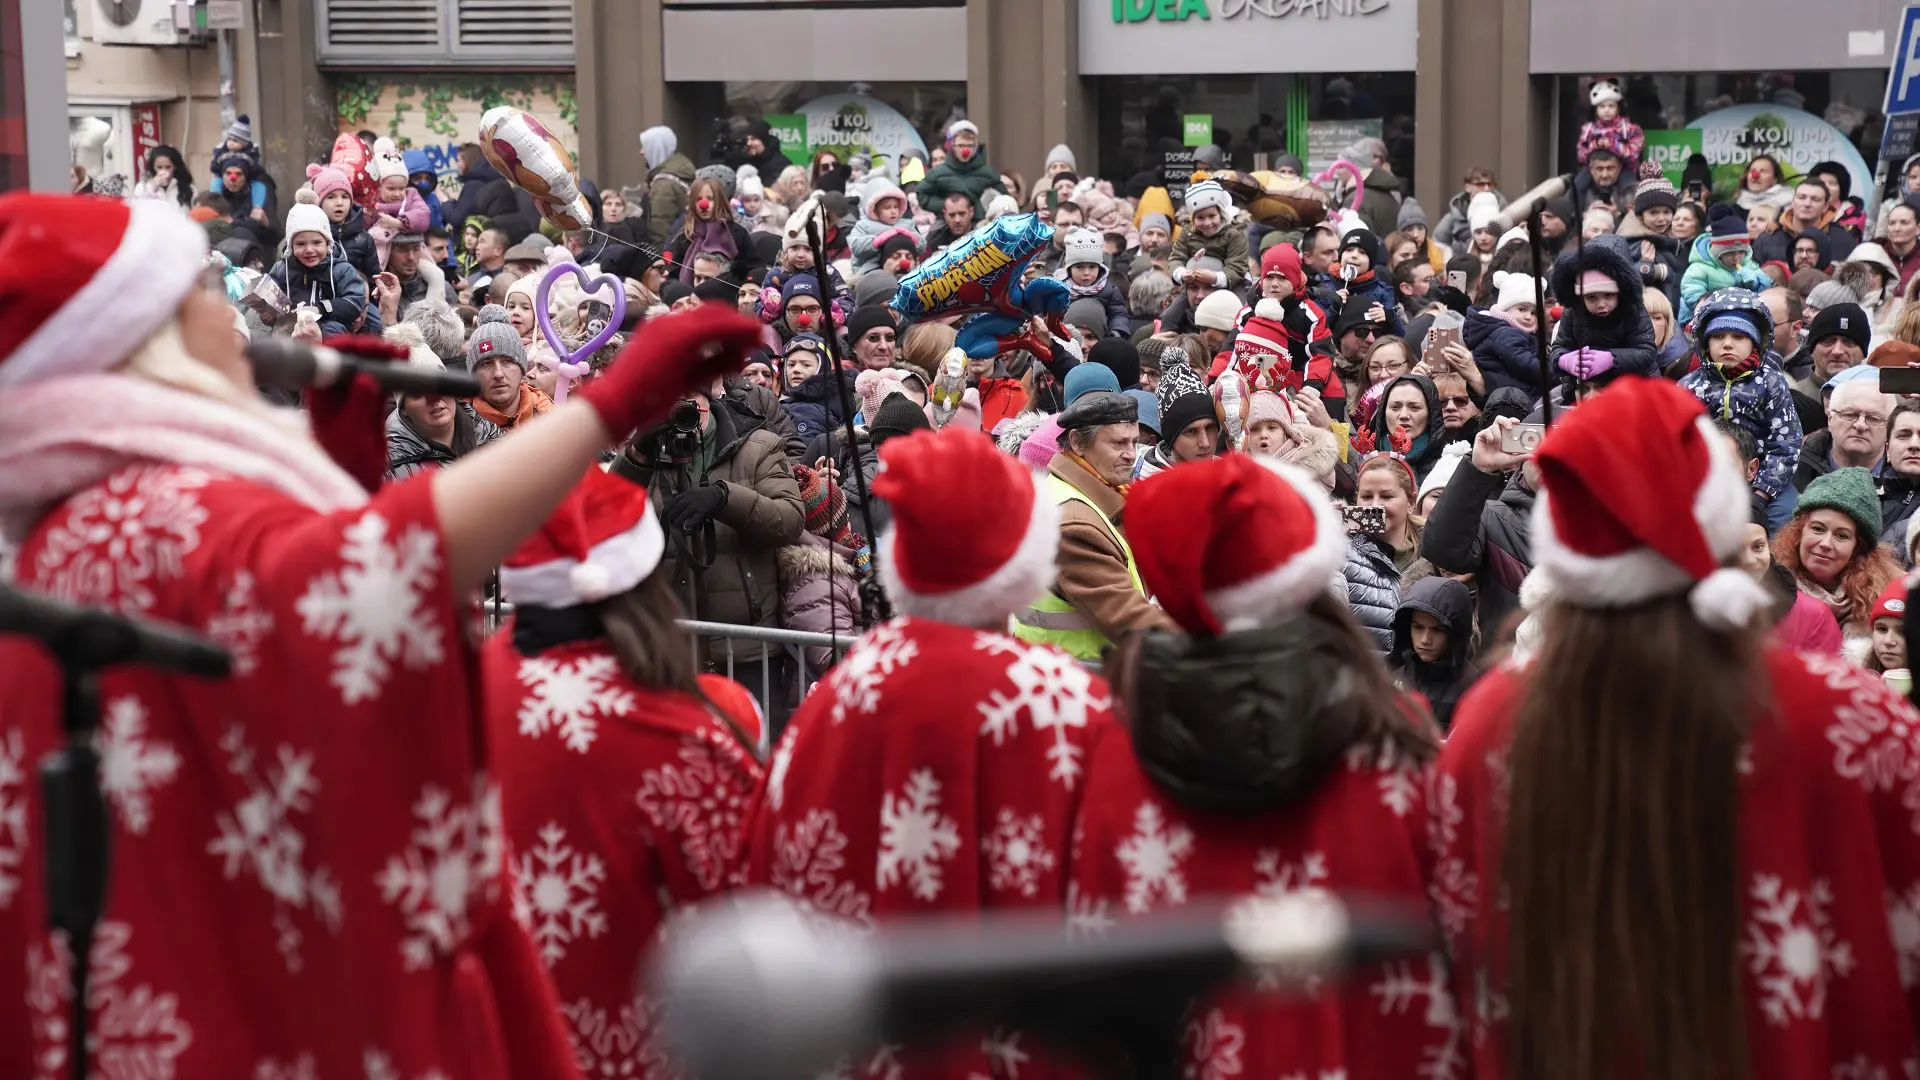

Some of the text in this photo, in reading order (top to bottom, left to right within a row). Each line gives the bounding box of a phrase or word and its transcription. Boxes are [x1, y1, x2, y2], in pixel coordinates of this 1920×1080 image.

[1111, 0, 1210, 22] IDEA
[1706, 127, 1836, 146] SVET KOJI IMA
[917, 243, 1012, 312] SPIDER-MAN
